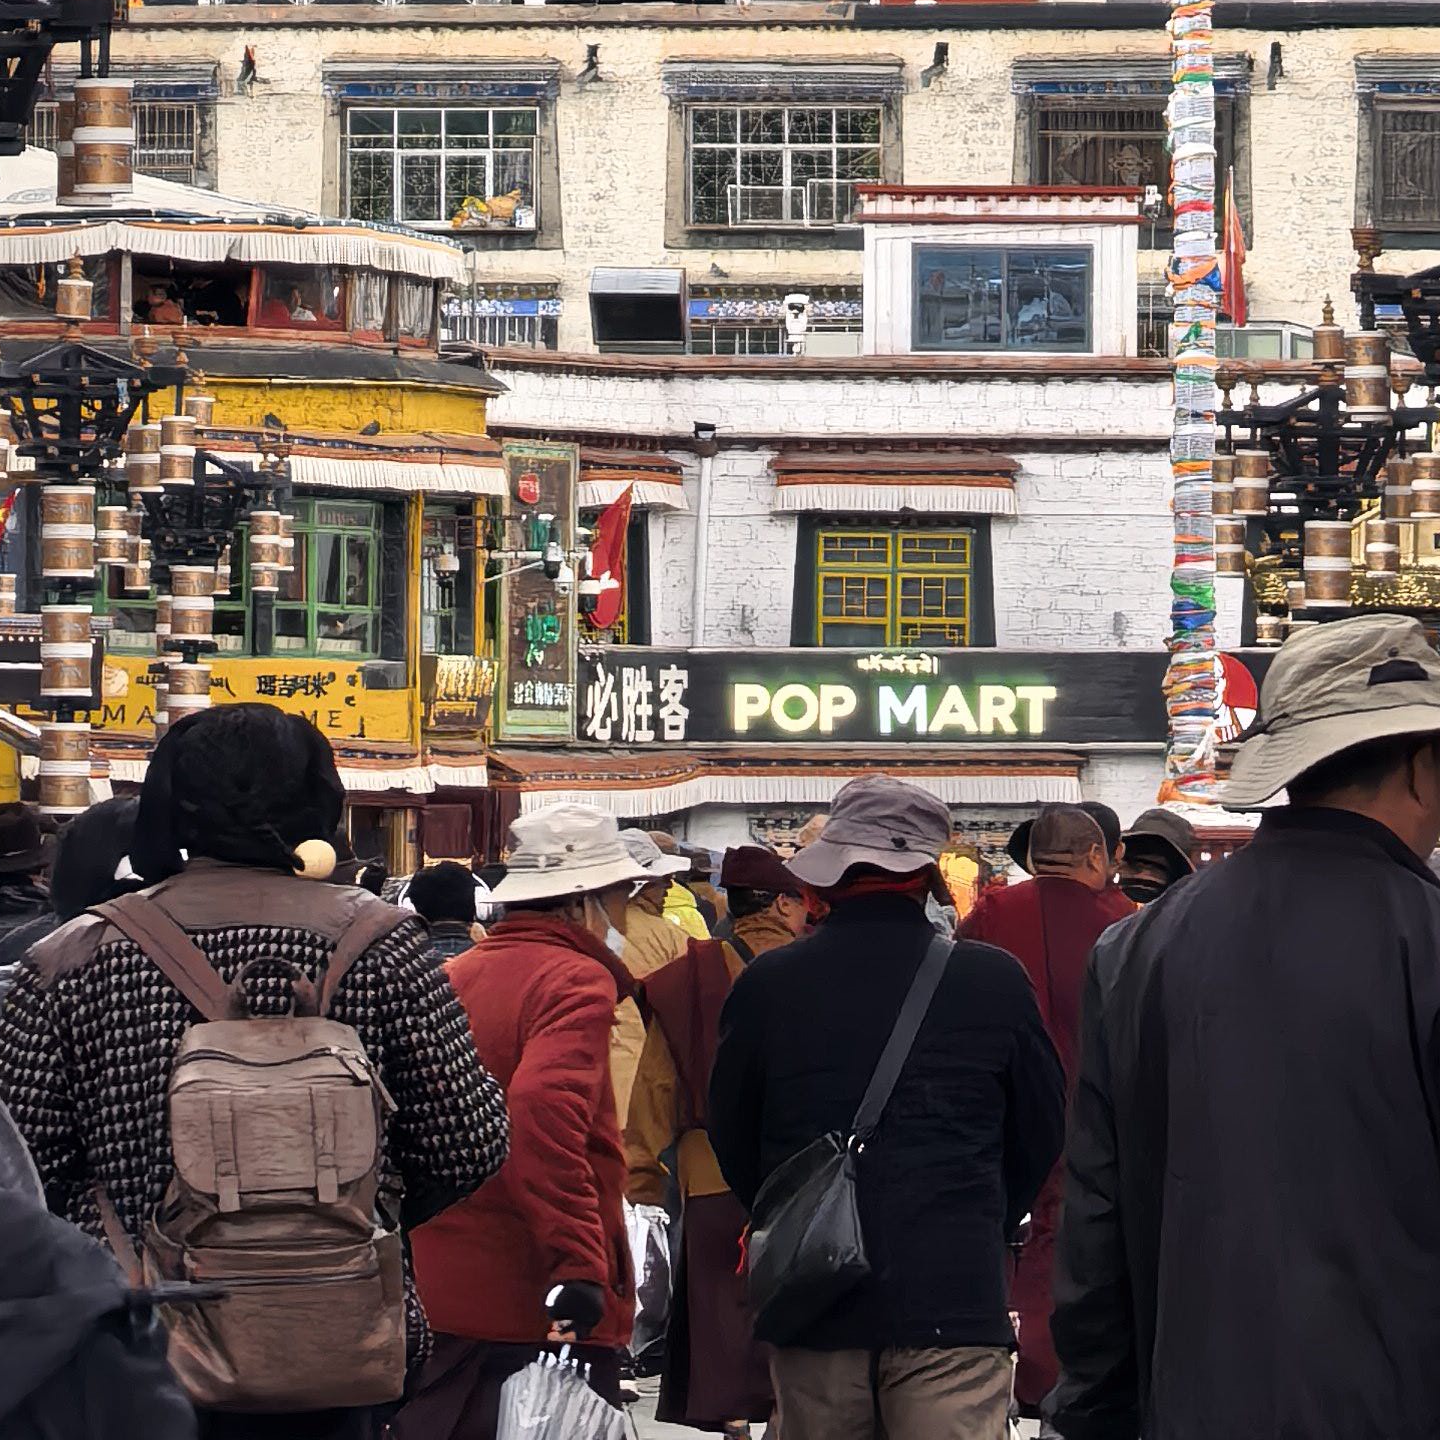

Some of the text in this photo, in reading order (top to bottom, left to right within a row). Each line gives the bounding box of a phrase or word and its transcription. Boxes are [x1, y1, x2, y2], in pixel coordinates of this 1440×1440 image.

[586, 663, 690, 742] 必胜客
[733, 683, 1058, 734] POP MART
